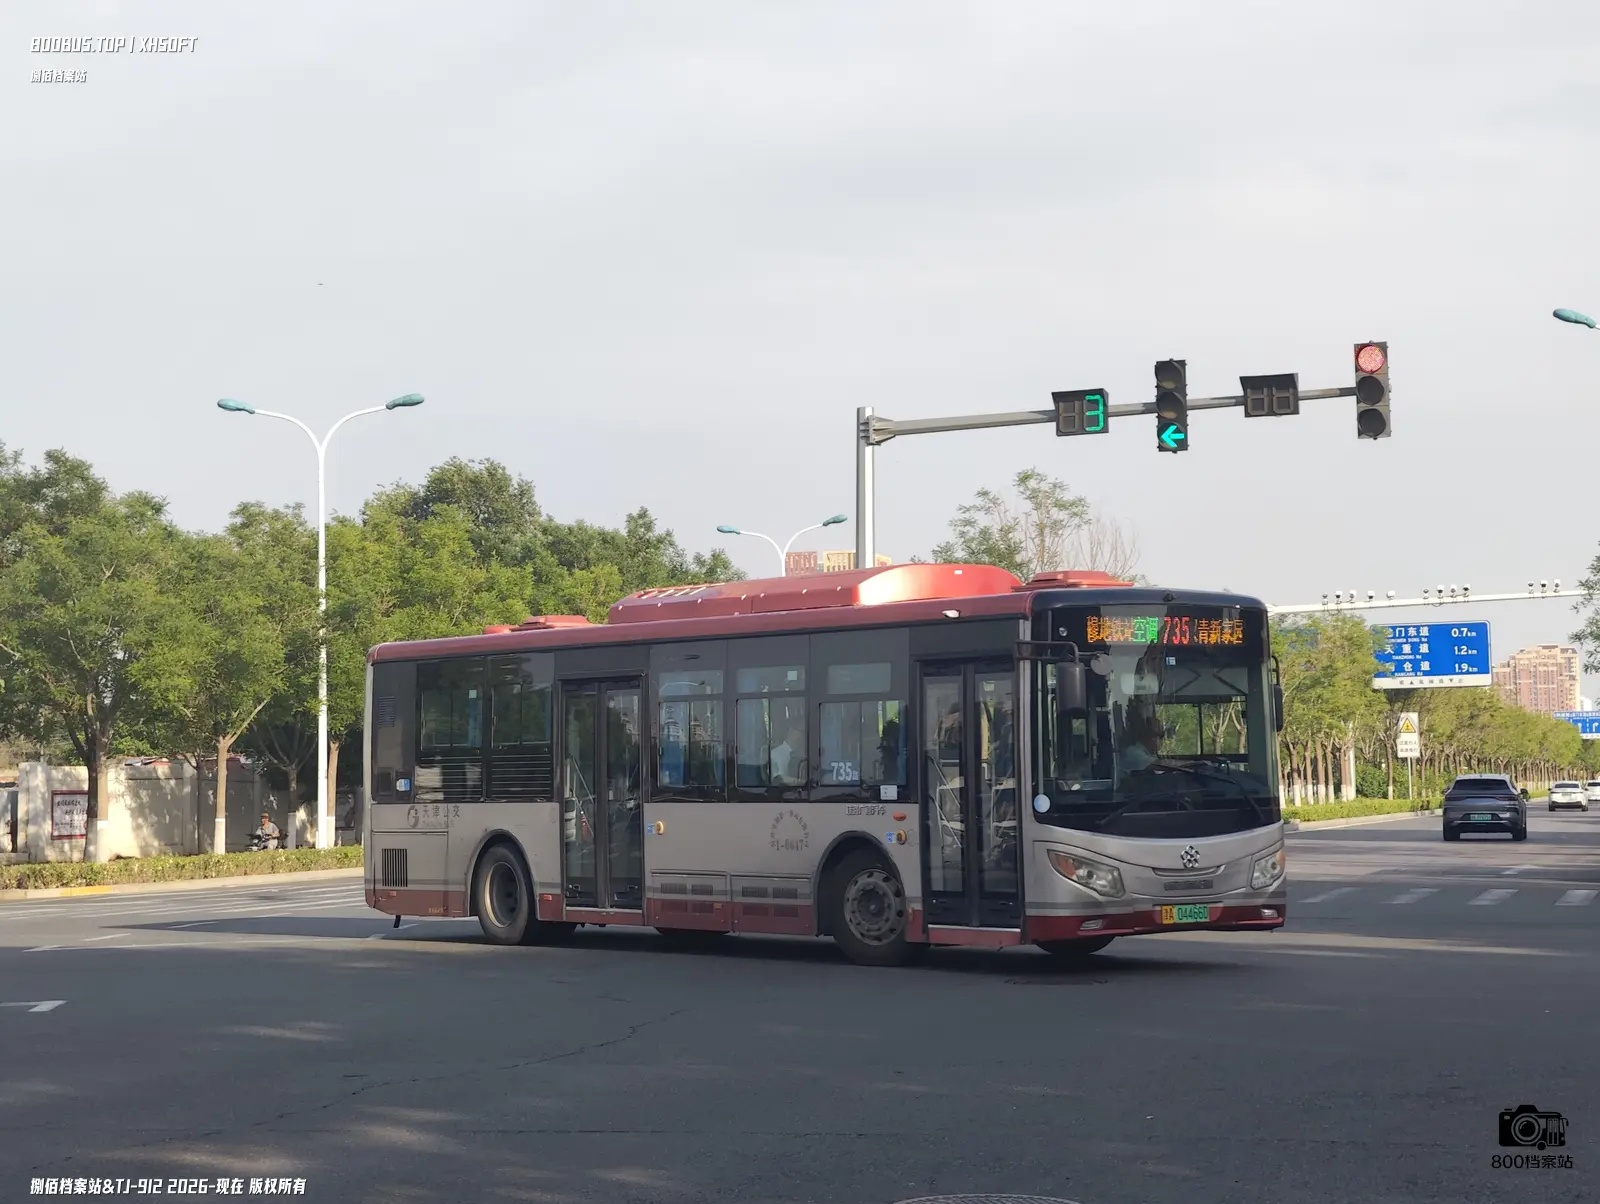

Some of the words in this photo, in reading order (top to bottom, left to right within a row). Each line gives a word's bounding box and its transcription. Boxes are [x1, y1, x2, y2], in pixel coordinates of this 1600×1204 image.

[1133, 617, 1158, 643] 空调
[1163, 617, 1190, 644] 735
[1451, 628, 1477, 637] 0.7km
[1454, 645, 1478, 655] 1.2km
[1454, 663, 1479, 673] 1.9km
[422, 804, 460, 818] 天津公交
